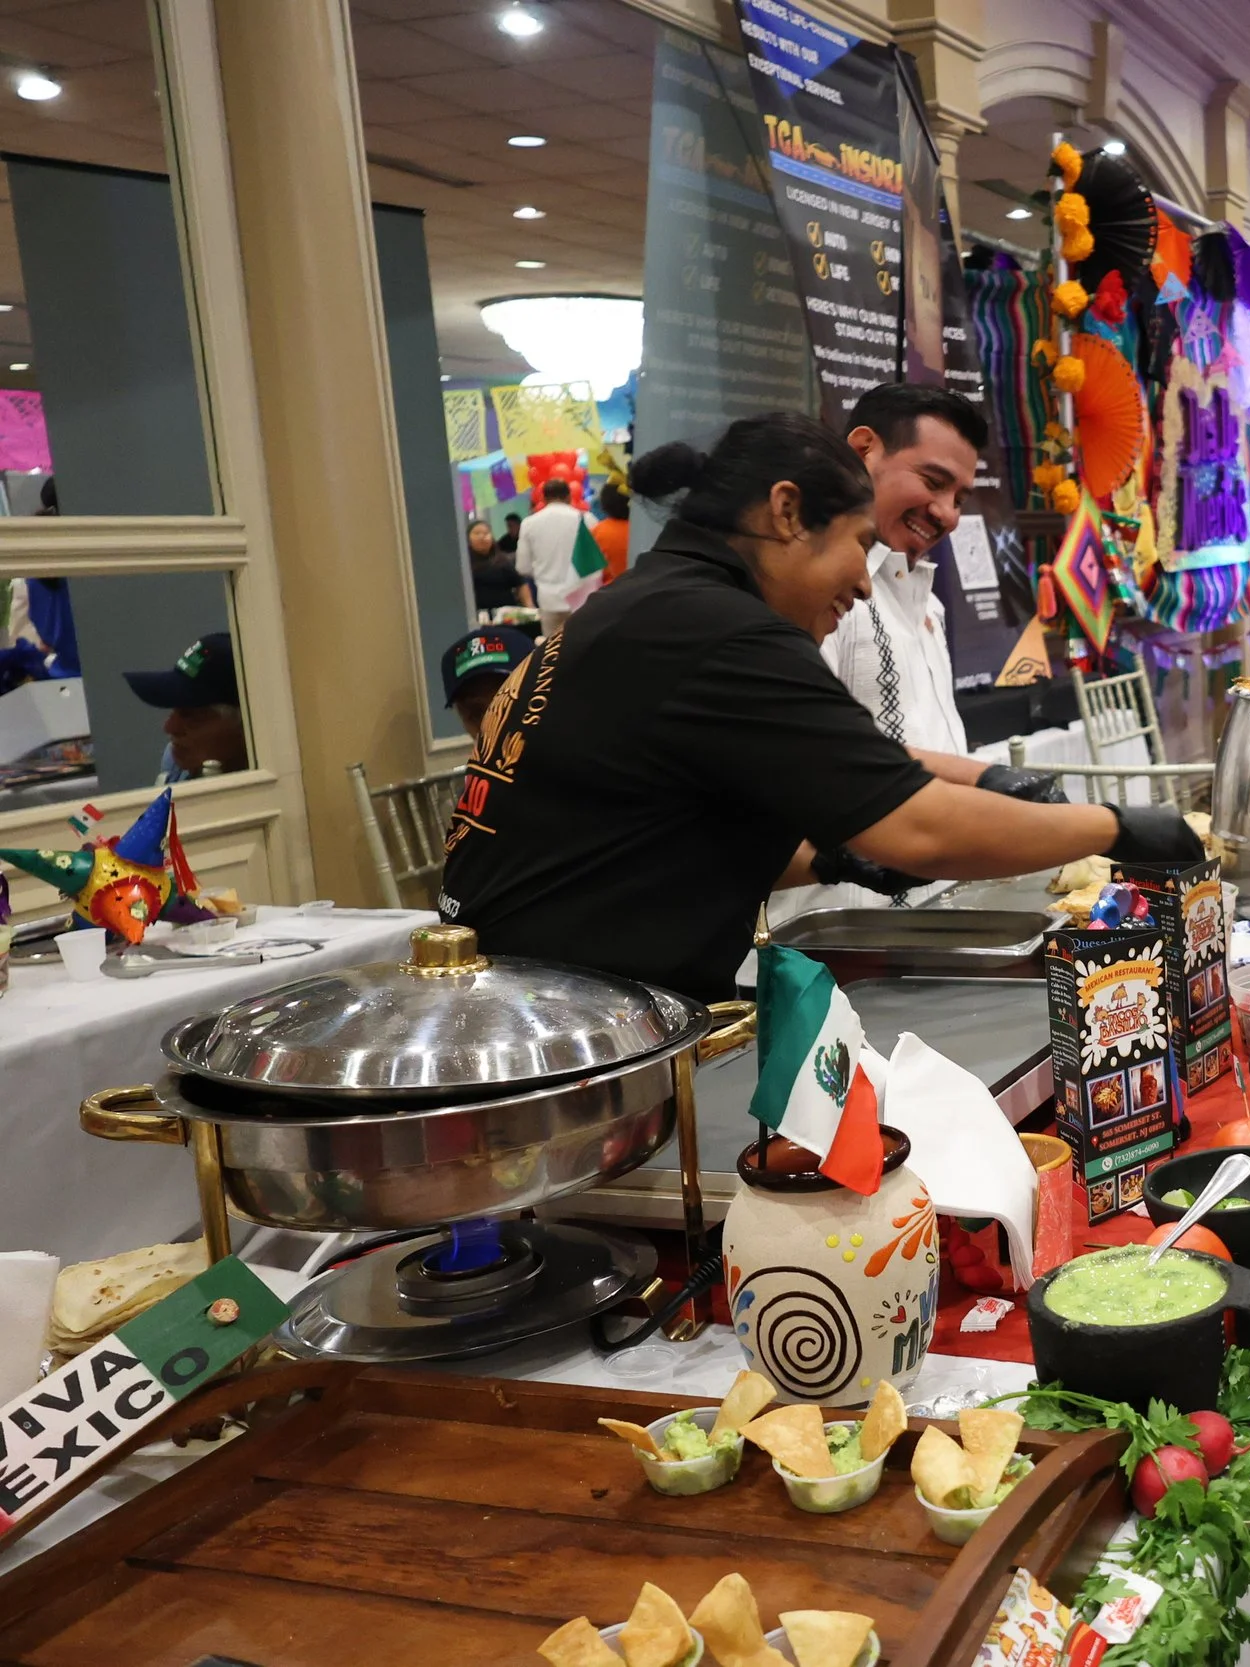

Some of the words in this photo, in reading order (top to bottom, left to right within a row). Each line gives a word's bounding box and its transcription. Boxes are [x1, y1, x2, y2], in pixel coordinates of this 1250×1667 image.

[764, 114, 809, 162] TCA
[1085, 972, 1113, 992] MEXICAN
[1114, 967, 1154, 977] RESTAURANT
[1100, 1014, 1148, 1039] BASILIO
[1108, 1006, 1139, 1025] TACOS
[1114, 1115, 1150, 1134] SOMERSET
[1151, 1111, 1162, 1121] ST.
[1140, 1127, 1148, 1138] NJ
[0, 1347, 210, 1516] EXICO
